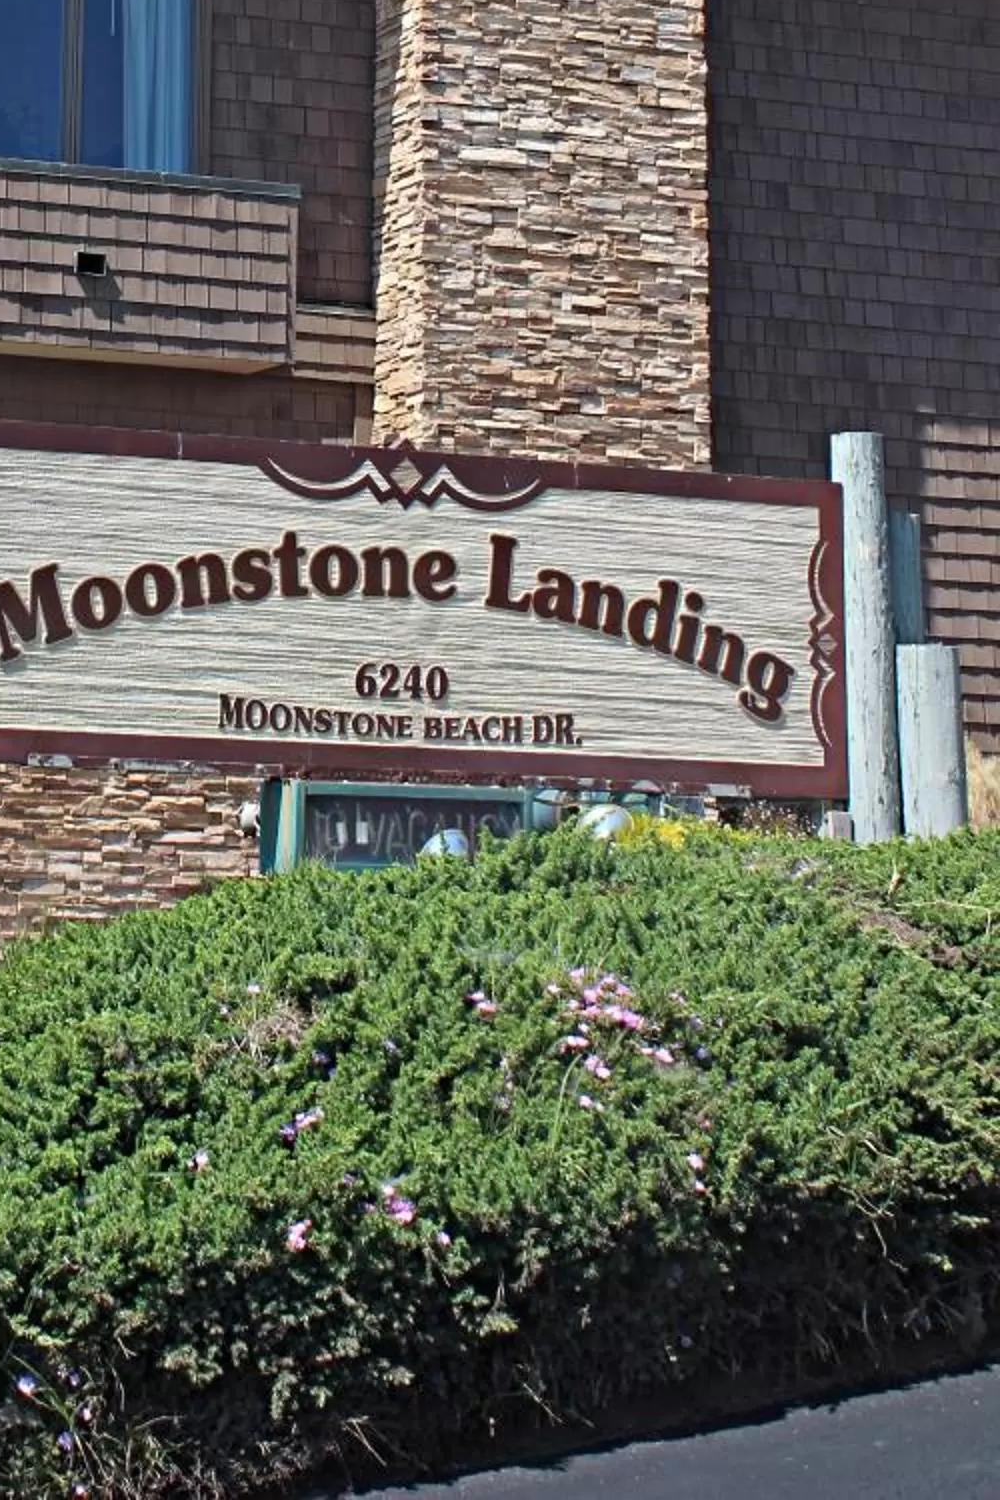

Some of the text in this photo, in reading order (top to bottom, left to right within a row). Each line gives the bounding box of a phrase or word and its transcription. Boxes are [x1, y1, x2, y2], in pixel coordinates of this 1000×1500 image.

[486, 533, 795, 723] Landing
[355, 663, 450, 701] 6240
[218, 694, 585, 746] MOONSTONE BEACH DR.
